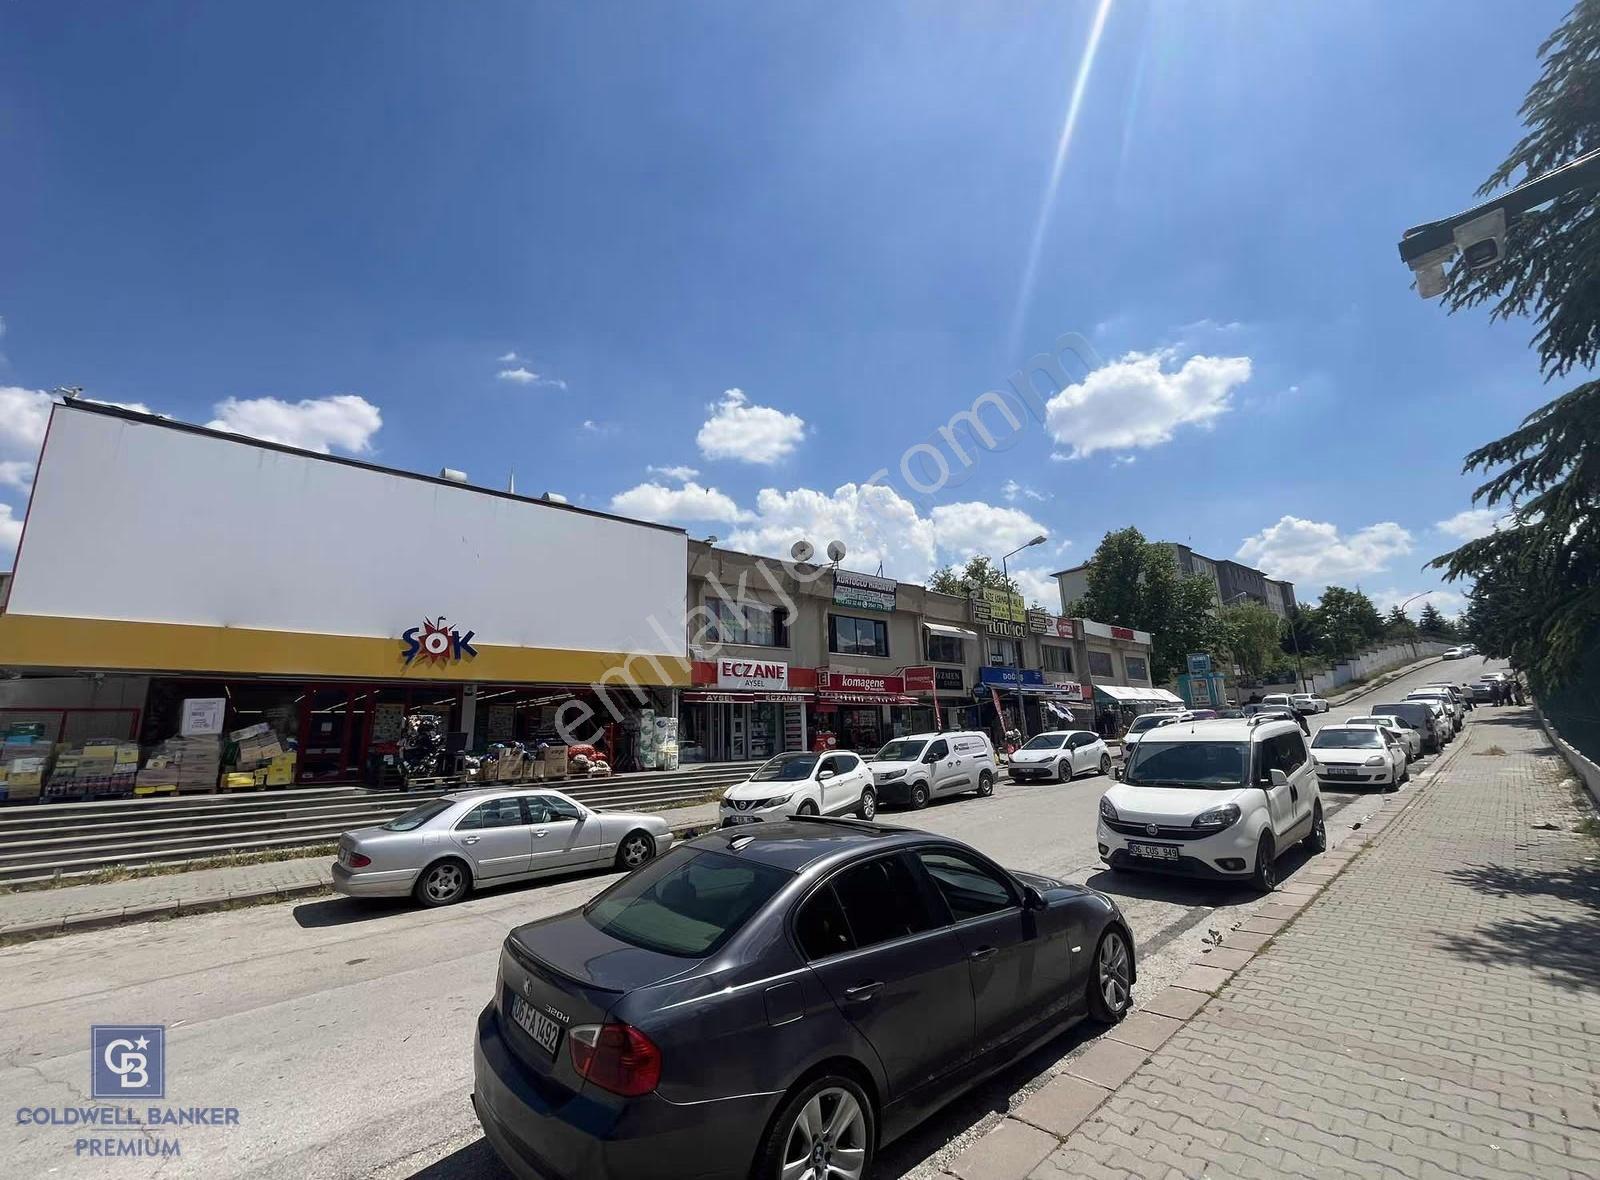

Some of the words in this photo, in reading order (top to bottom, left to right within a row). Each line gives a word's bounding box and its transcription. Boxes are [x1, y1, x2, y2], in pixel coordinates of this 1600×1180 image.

[722, 662, 785, 680] ECZANE
[744, 680, 765, 688] AYSEL
[842, 675, 885, 691] komagene
[1164, 848, 1177, 857] 949
[544, 1003, 570, 1023] 320d
[535, 1014, 558, 1051] 1492
